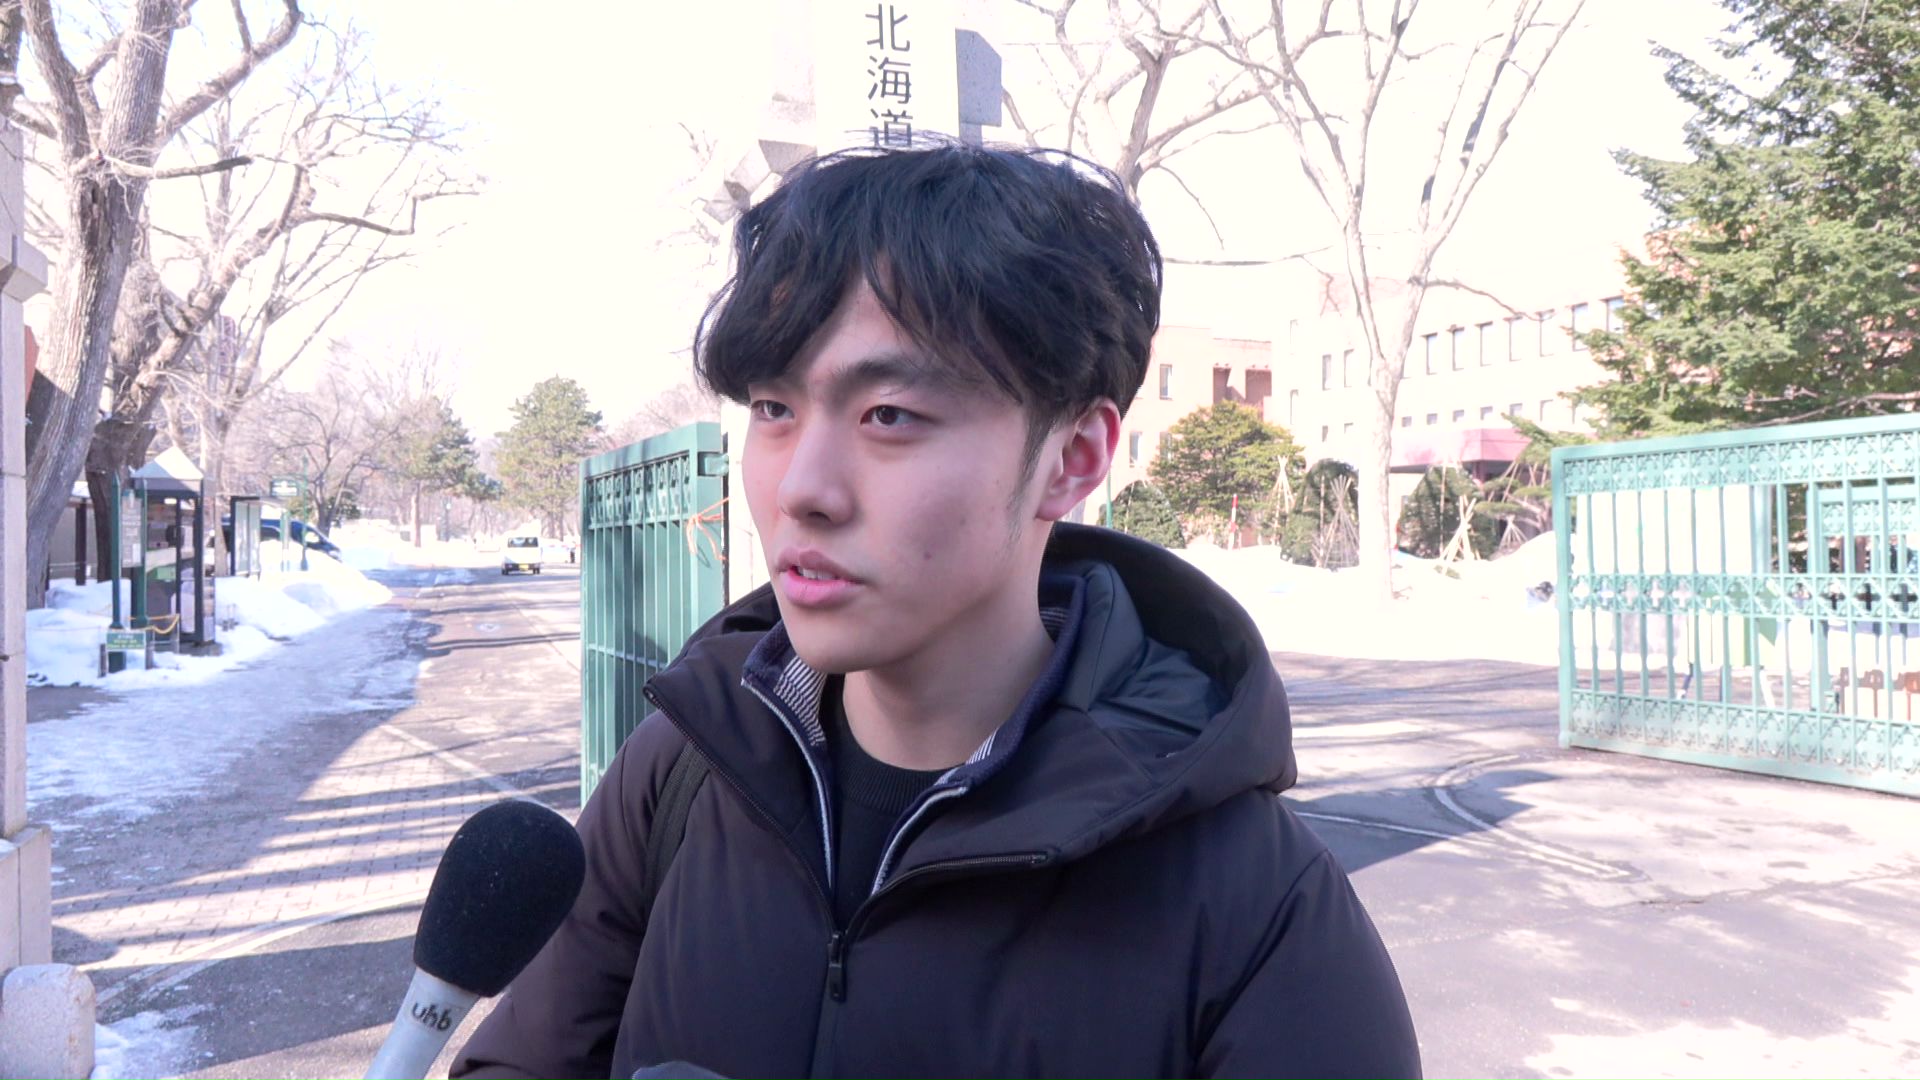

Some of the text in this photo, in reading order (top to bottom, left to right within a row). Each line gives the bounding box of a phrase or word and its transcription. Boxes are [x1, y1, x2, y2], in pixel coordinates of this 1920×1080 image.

[865, 3, 914, 148] 北海道
[412, 1002, 452, 1031] uhb
